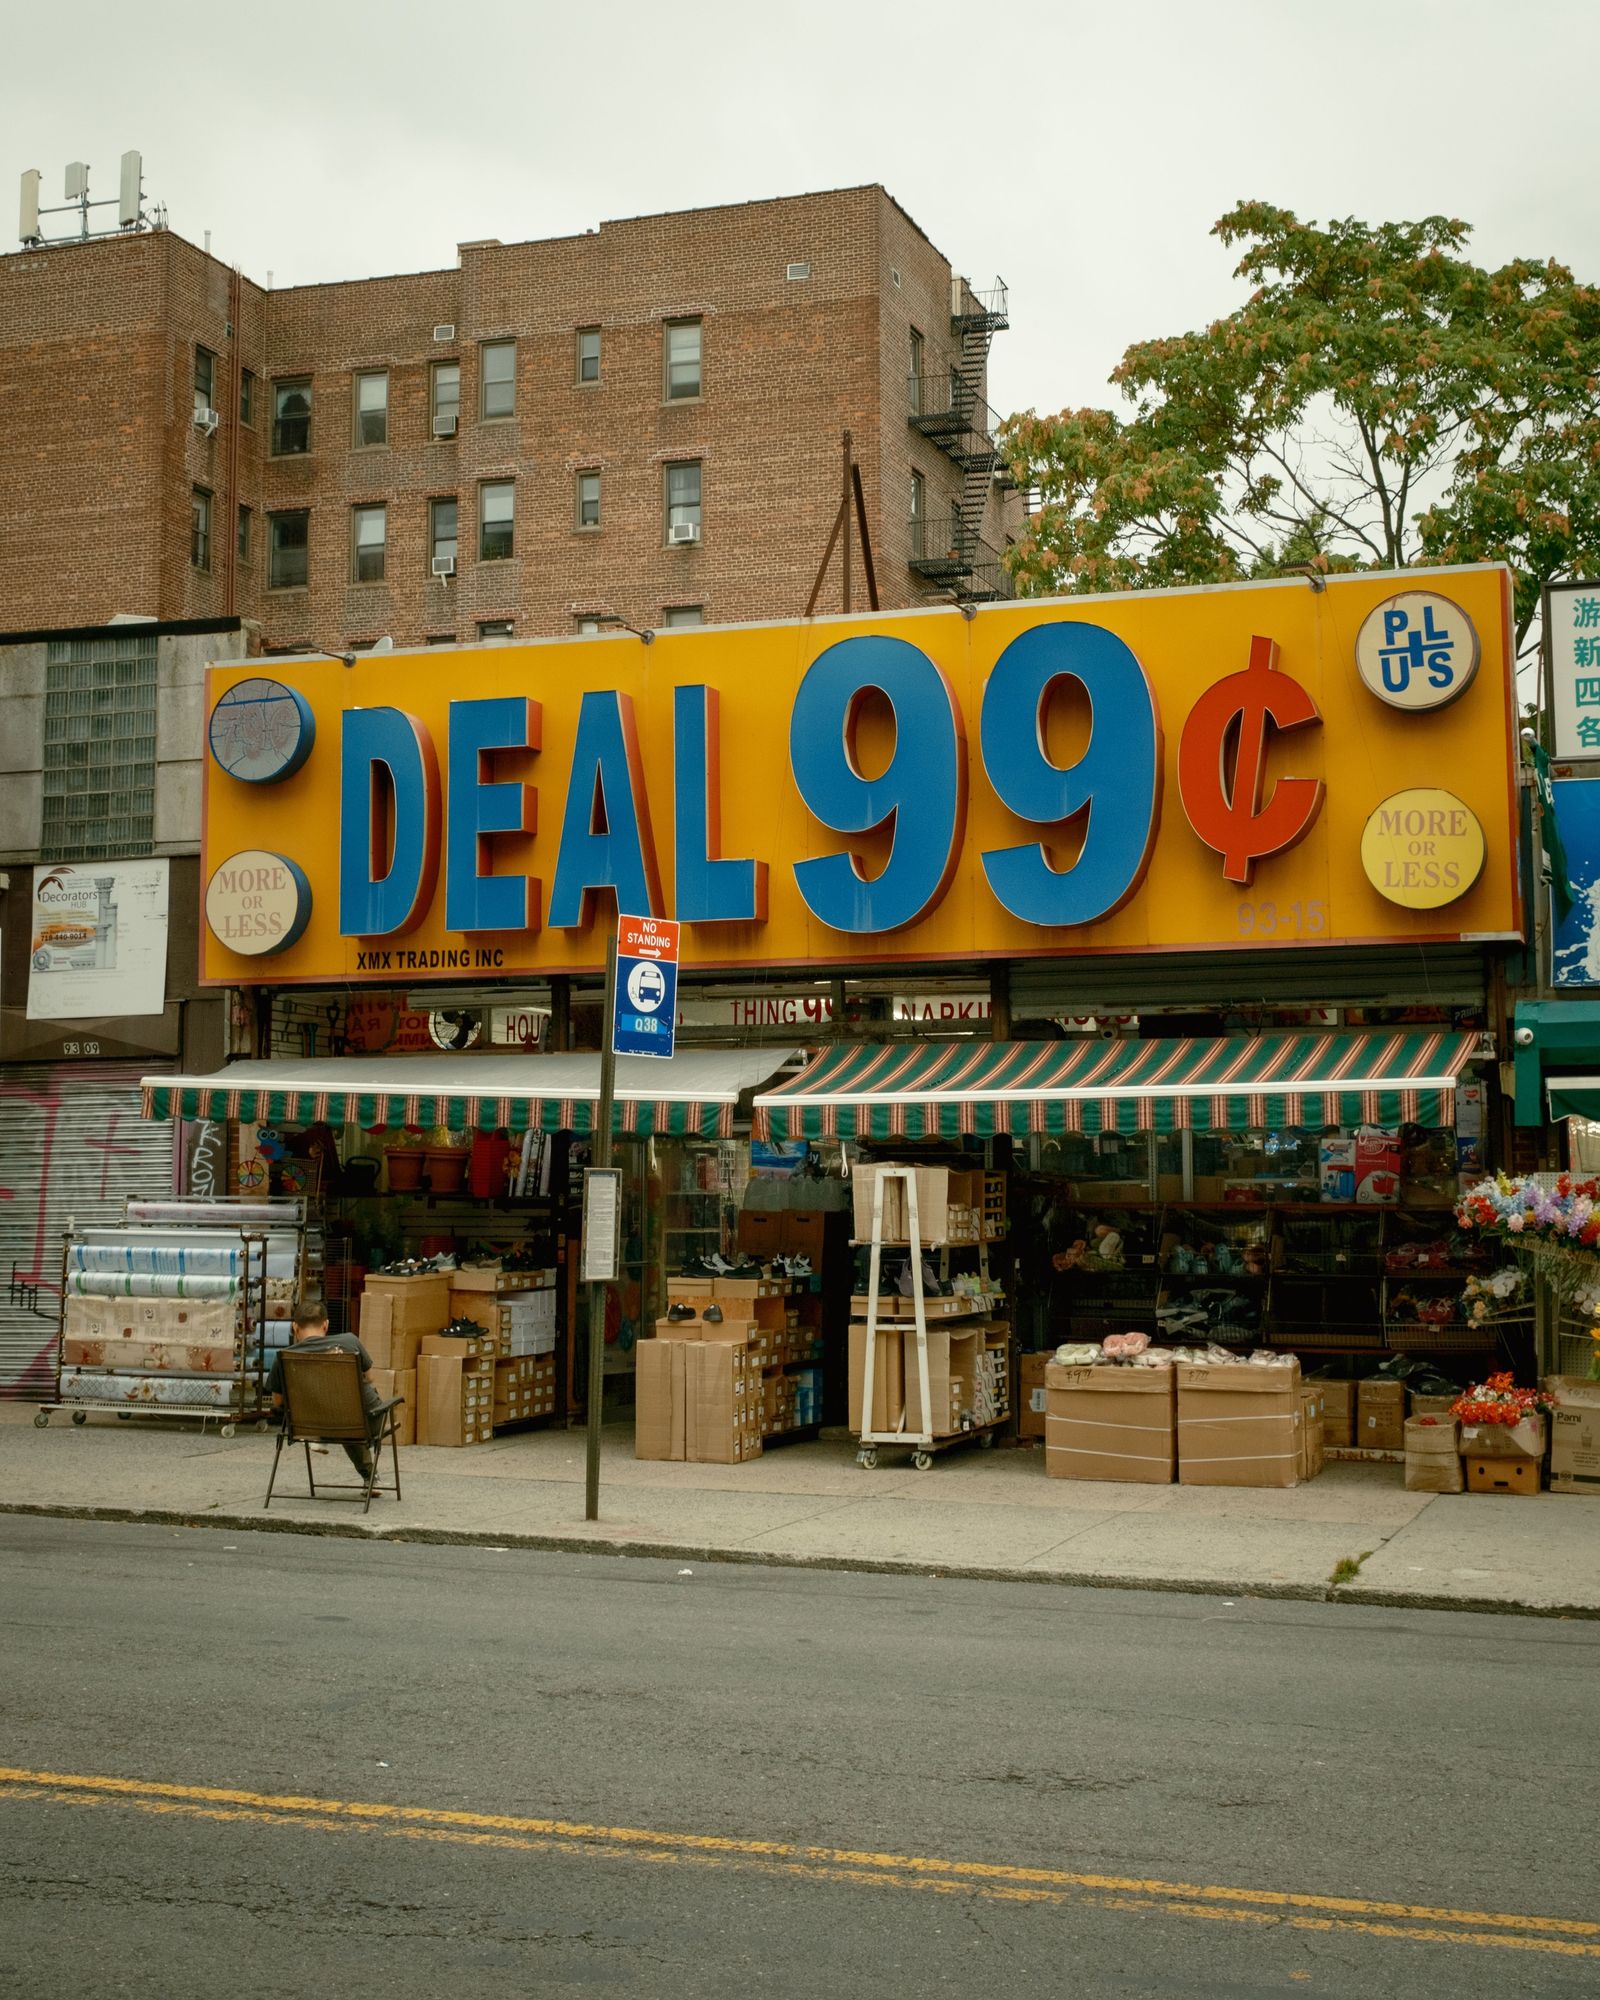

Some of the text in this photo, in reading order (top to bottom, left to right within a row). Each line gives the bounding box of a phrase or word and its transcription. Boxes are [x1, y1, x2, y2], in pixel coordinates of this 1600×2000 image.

[340, 684, 767, 938] DEAL
[1378, 809, 1468, 837] MORE
[1408, 840, 1436, 857] OR
[218, 867, 287, 894] MORE
[1383, 861, 1460, 889] LESS
[41, 890, 98, 903] Decorators
[70, 901, 87, 909] HUB
[241, 896, 263, 910] OR
[224, 911, 283, 938] LESS
[1237, 901, 1326, 935] 93-15
[642, 922, 657, 934] NO
[627, 933, 671, 948] STANDING
[356, 949, 504, 970] XMX TRADING INC
[634, 1017, 658, 1033] Q38
